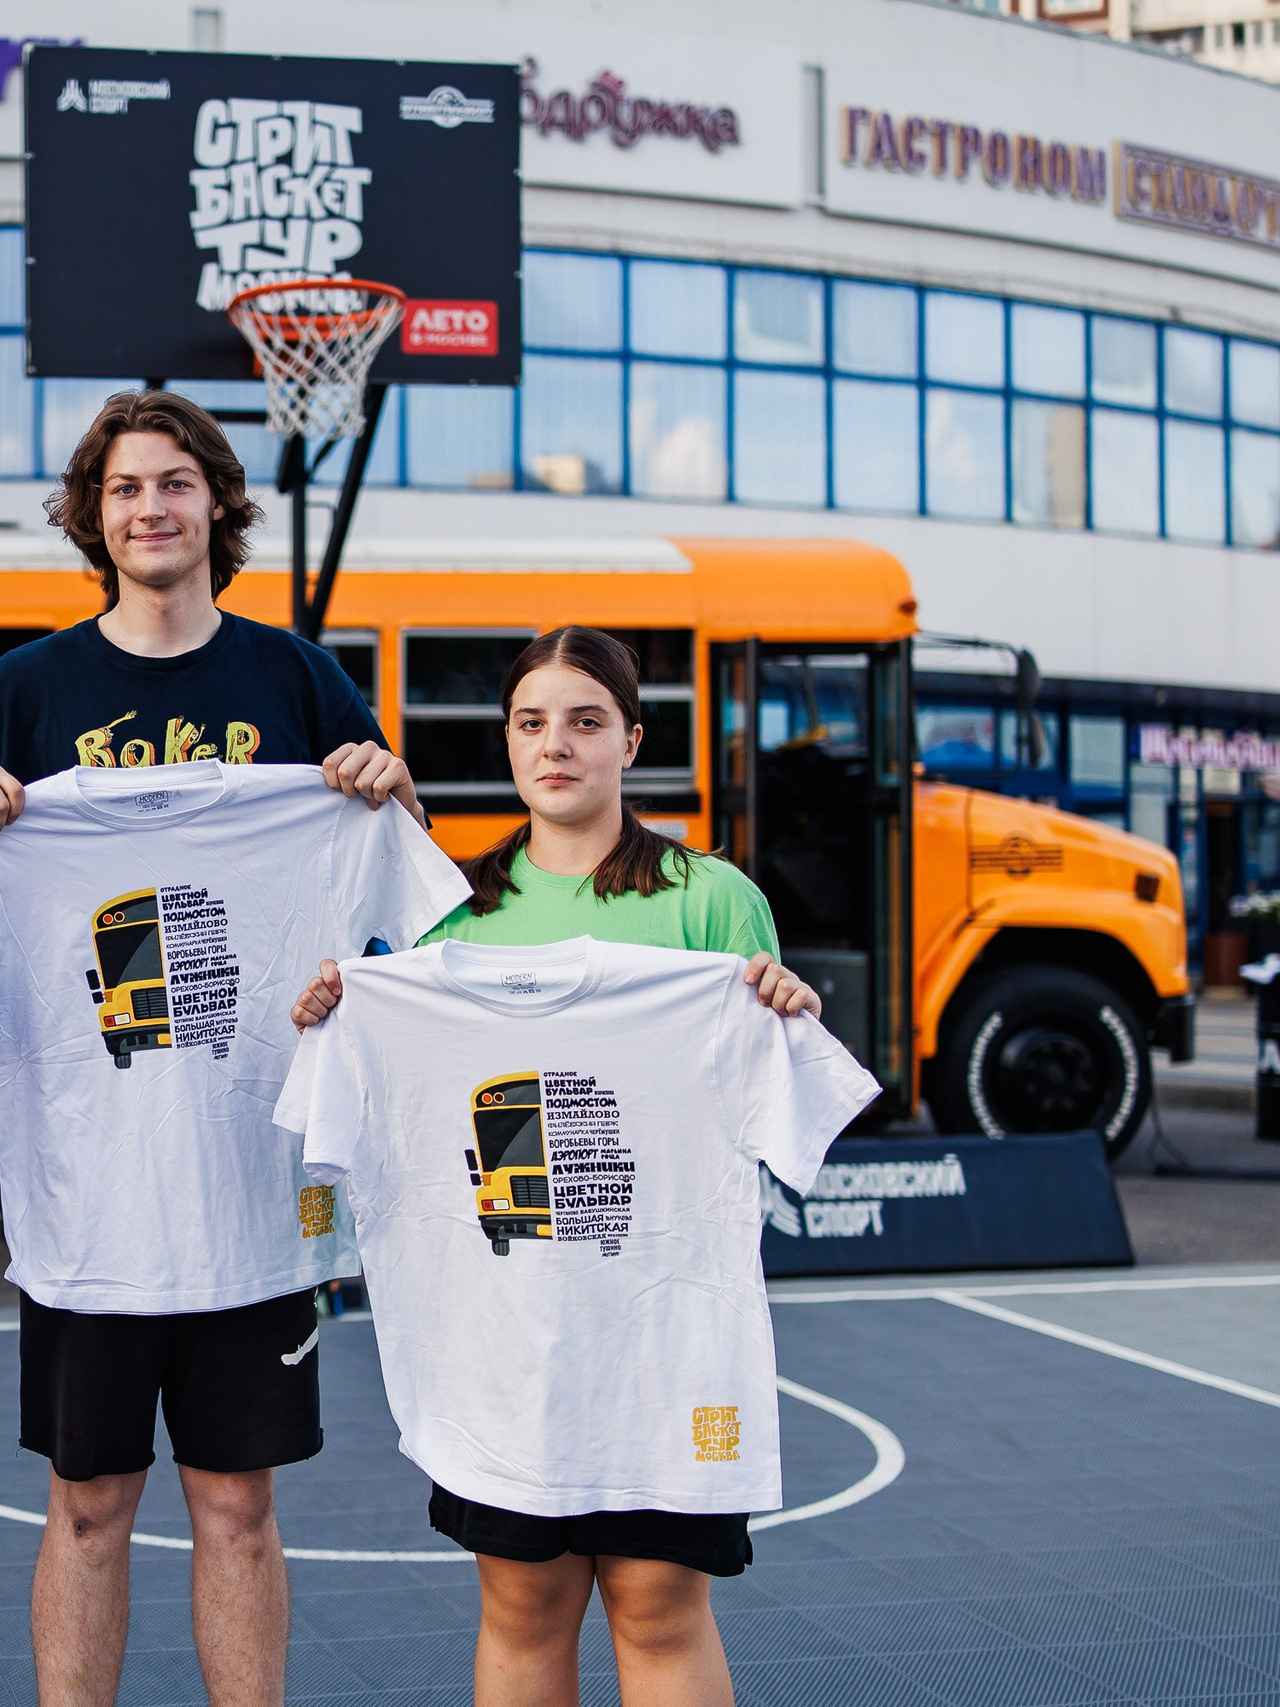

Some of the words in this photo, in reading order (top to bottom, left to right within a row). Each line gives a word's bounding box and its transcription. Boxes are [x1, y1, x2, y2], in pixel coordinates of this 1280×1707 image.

[194, 98, 363, 175] СТРИТ
[841, 104, 1107, 206] ГАСТРОНОМ
[188, 161, 373, 229] БАСКЕТ
[194, 218, 363, 274] ТУР
[410, 308, 489, 333] ЛЕТО
[162, 888, 208, 902] ЦВЕТНОЙ
[163, 899, 205, 910] БУЛЬВАР
[163, 907, 226, 922] ПОДМОСТОМ
[164, 919, 228, 933] ИЗМАЙЛОВО
[208, 944, 227, 953] ГОРЫ
[169, 958, 209, 972] АЭРОПОРТ
[170, 966, 240, 985] ЛУЖНИКИ
[171, 978, 240, 993] ОРЕХОВО-БОРИСОВО
[172, 985, 238, 1006] ЦВЕТНОЙ
[173, 999, 236, 1017] БУЛЬВАР
[175, 1020, 214, 1032] БОЛЬШАЯ
[176, 1025, 235, 1043] НИКИТСКАЯ
[545, 1077, 596, 1087] ЦВЕТНОЙ
[546, 1088, 592, 1096] БУЛЬВАР
[546, 1098, 617, 1109] ПОДМОСТОМ
[547, 1109, 620, 1120] ИЗМАЙЛОВО
[549, 1138, 595, 1148] ВОРОБЬЕВЫ
[597, 1137, 619, 1146] ГОРЫ
[551, 1149, 598, 1162] АЭРОПОРТ
[552, 1162, 635, 1175] ЛУЖНИКИ
[553, 1174, 635, 1183] ОРЕХОВО-БОРИСОВО
[554, 1179, 633, 1197] ЦВЕТНОЙ
[555, 1195, 631, 1209] БУЛЬВАР
[300, 1211, 333, 1228] ТУР
[556, 1214, 603, 1225] БОЛЬШАЯ
[804, 1201, 884, 1238] СПОРТ
[556, 1223, 628, 1235] НИКИТСКАЯ
[693, 1406, 738, 1425] СТРИТ
[692, 1422, 741, 1440] БАСКЕТ
[694, 1436, 739, 1452] ТУР
[695, 1450, 740, 1462] МОСКВА
